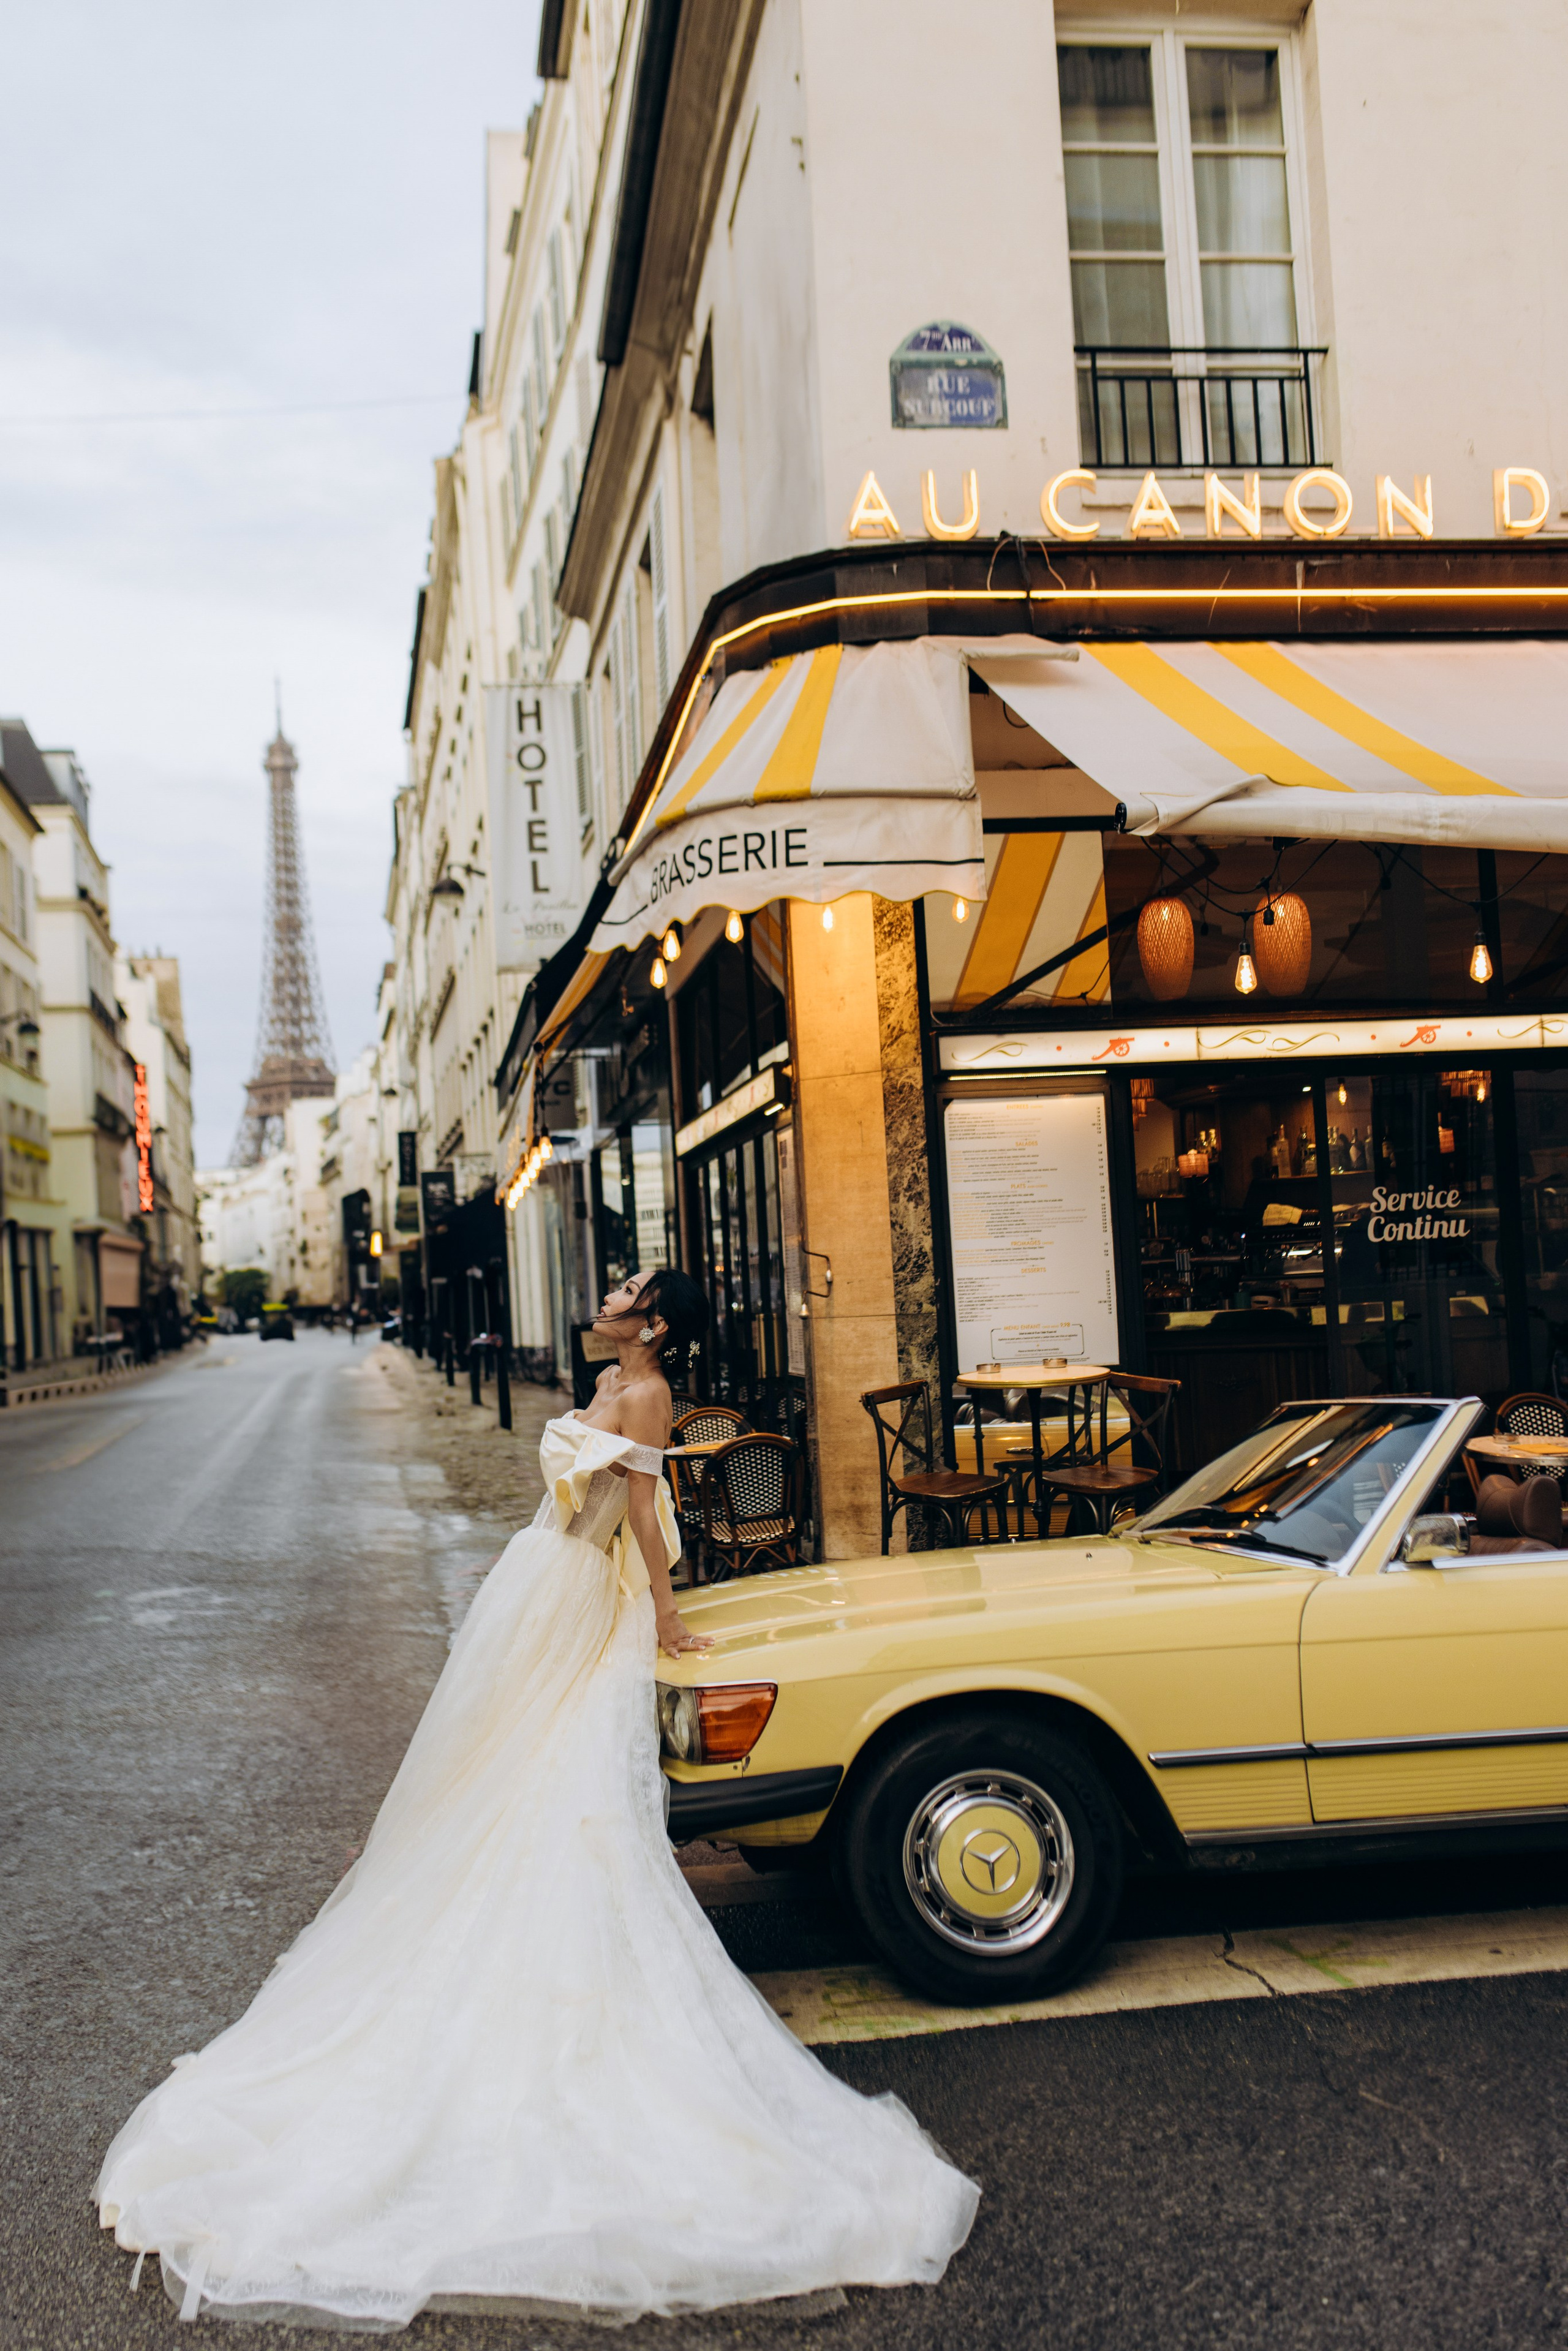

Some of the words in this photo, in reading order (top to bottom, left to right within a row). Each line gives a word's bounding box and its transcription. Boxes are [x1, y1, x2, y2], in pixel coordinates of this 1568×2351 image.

[847, 469, 979, 542] AU
[1041, 468, 1433, 540] CANON
[1493, 467, 1550, 537] D
[517, 700, 550, 894] HOTEL
[649, 828, 809, 905] BRASSERIE
[1367, 1214, 1470, 1243] Continu
[1370, 1184, 1461, 1213] Service
